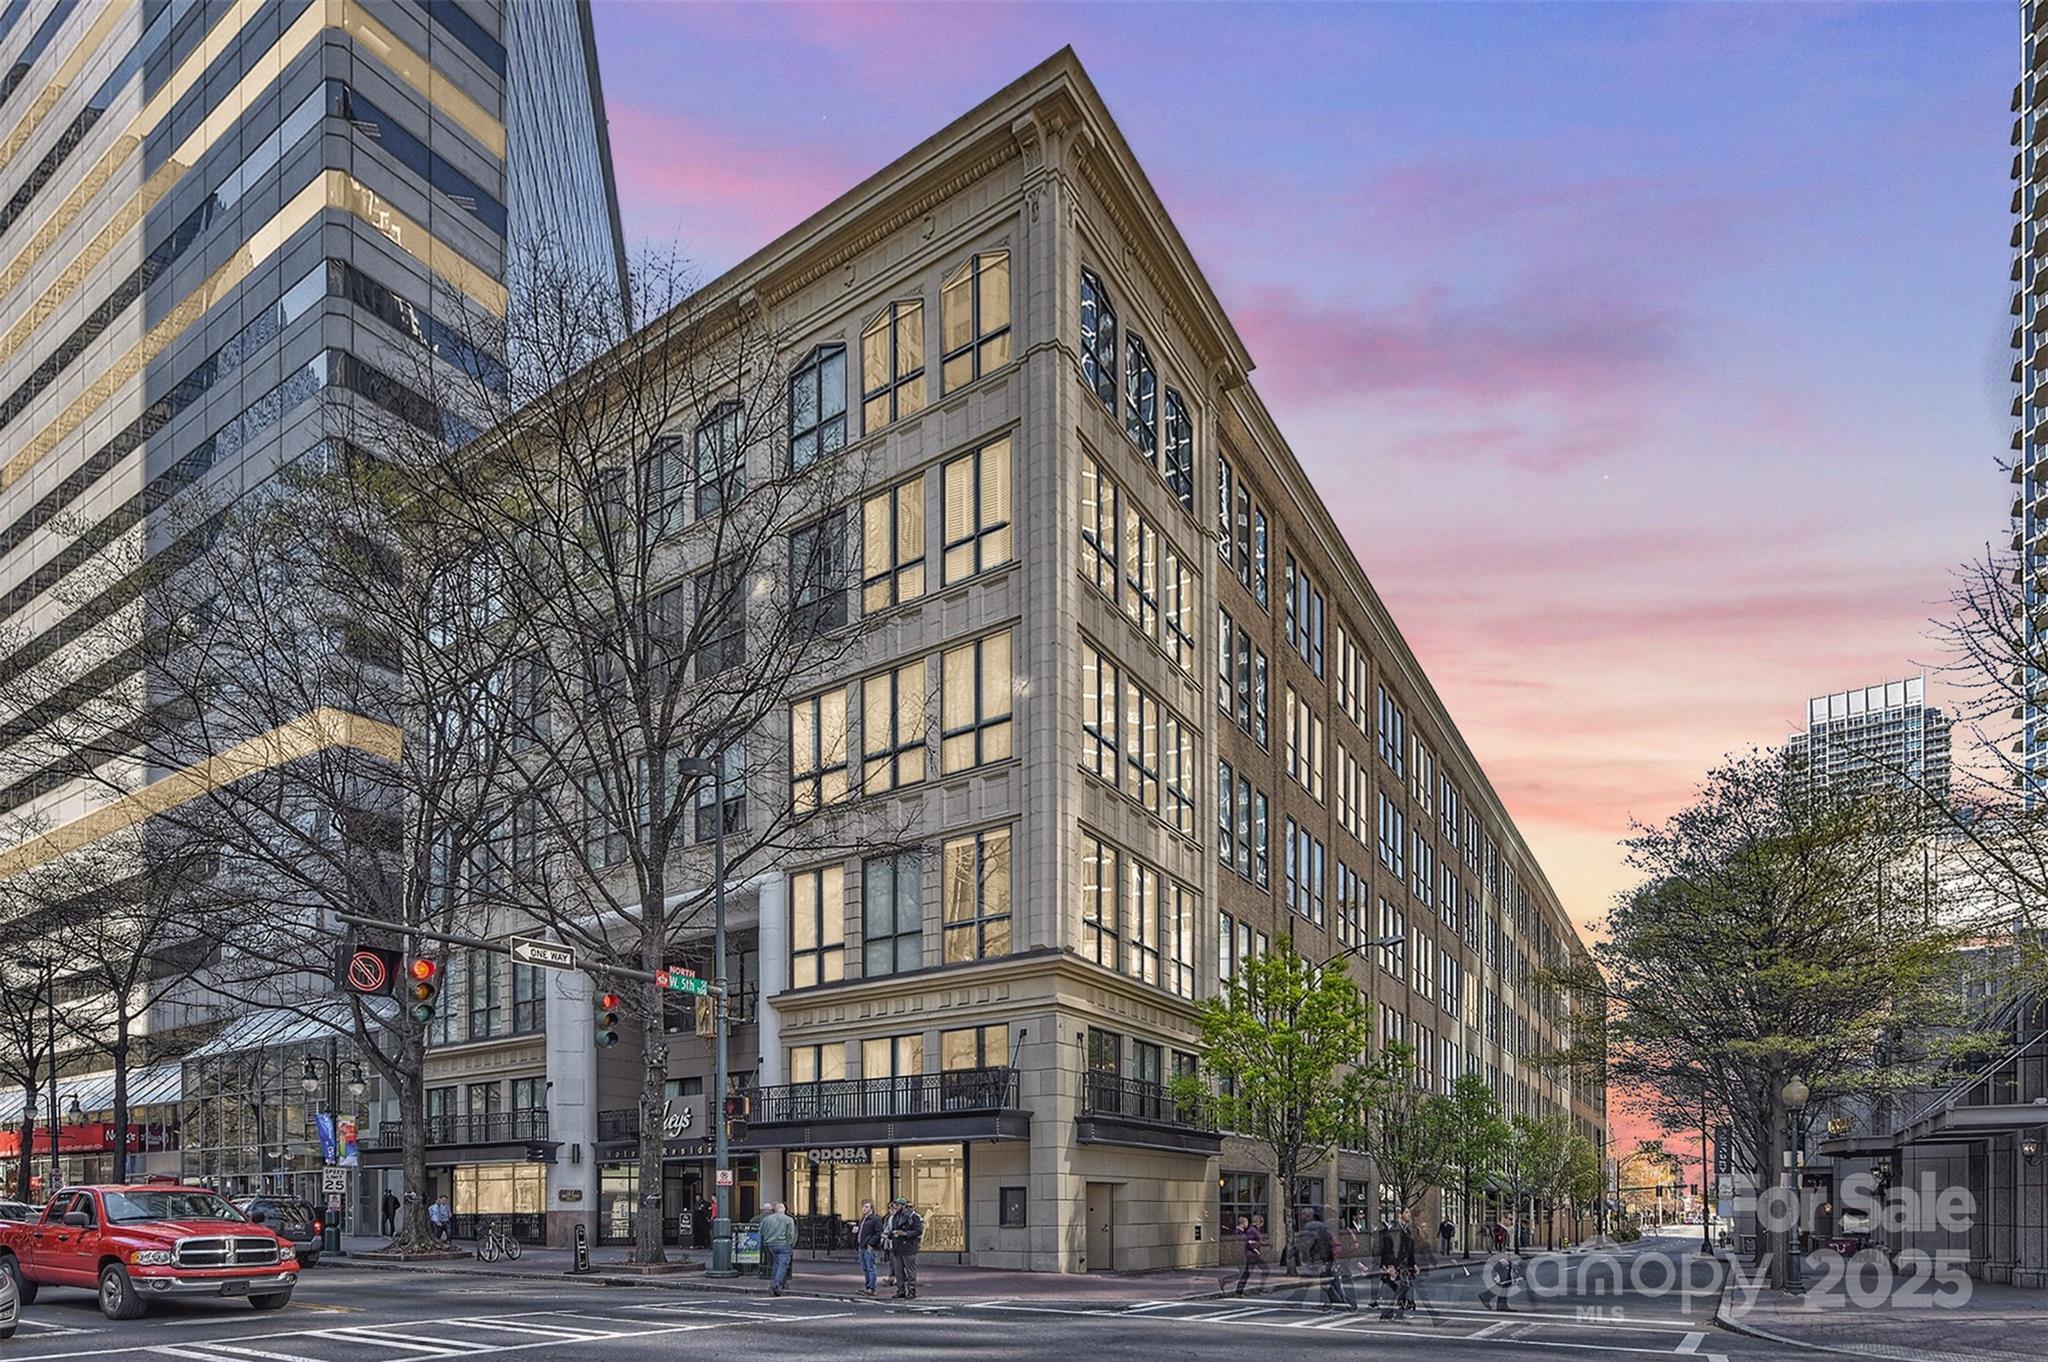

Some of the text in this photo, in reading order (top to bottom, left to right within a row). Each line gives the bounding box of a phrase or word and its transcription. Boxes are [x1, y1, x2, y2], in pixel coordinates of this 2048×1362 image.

[530, 948, 568, 962] ONE WAY
[669, 965, 696, 978] NORTH
[669, 975, 680, 989] W.
[681, 978, 695, 992] 5th
[607, 1150, 636, 1158] Hote
[808, 1147, 868, 1164] QDOBA
[324, 1180, 345, 1190] 25
